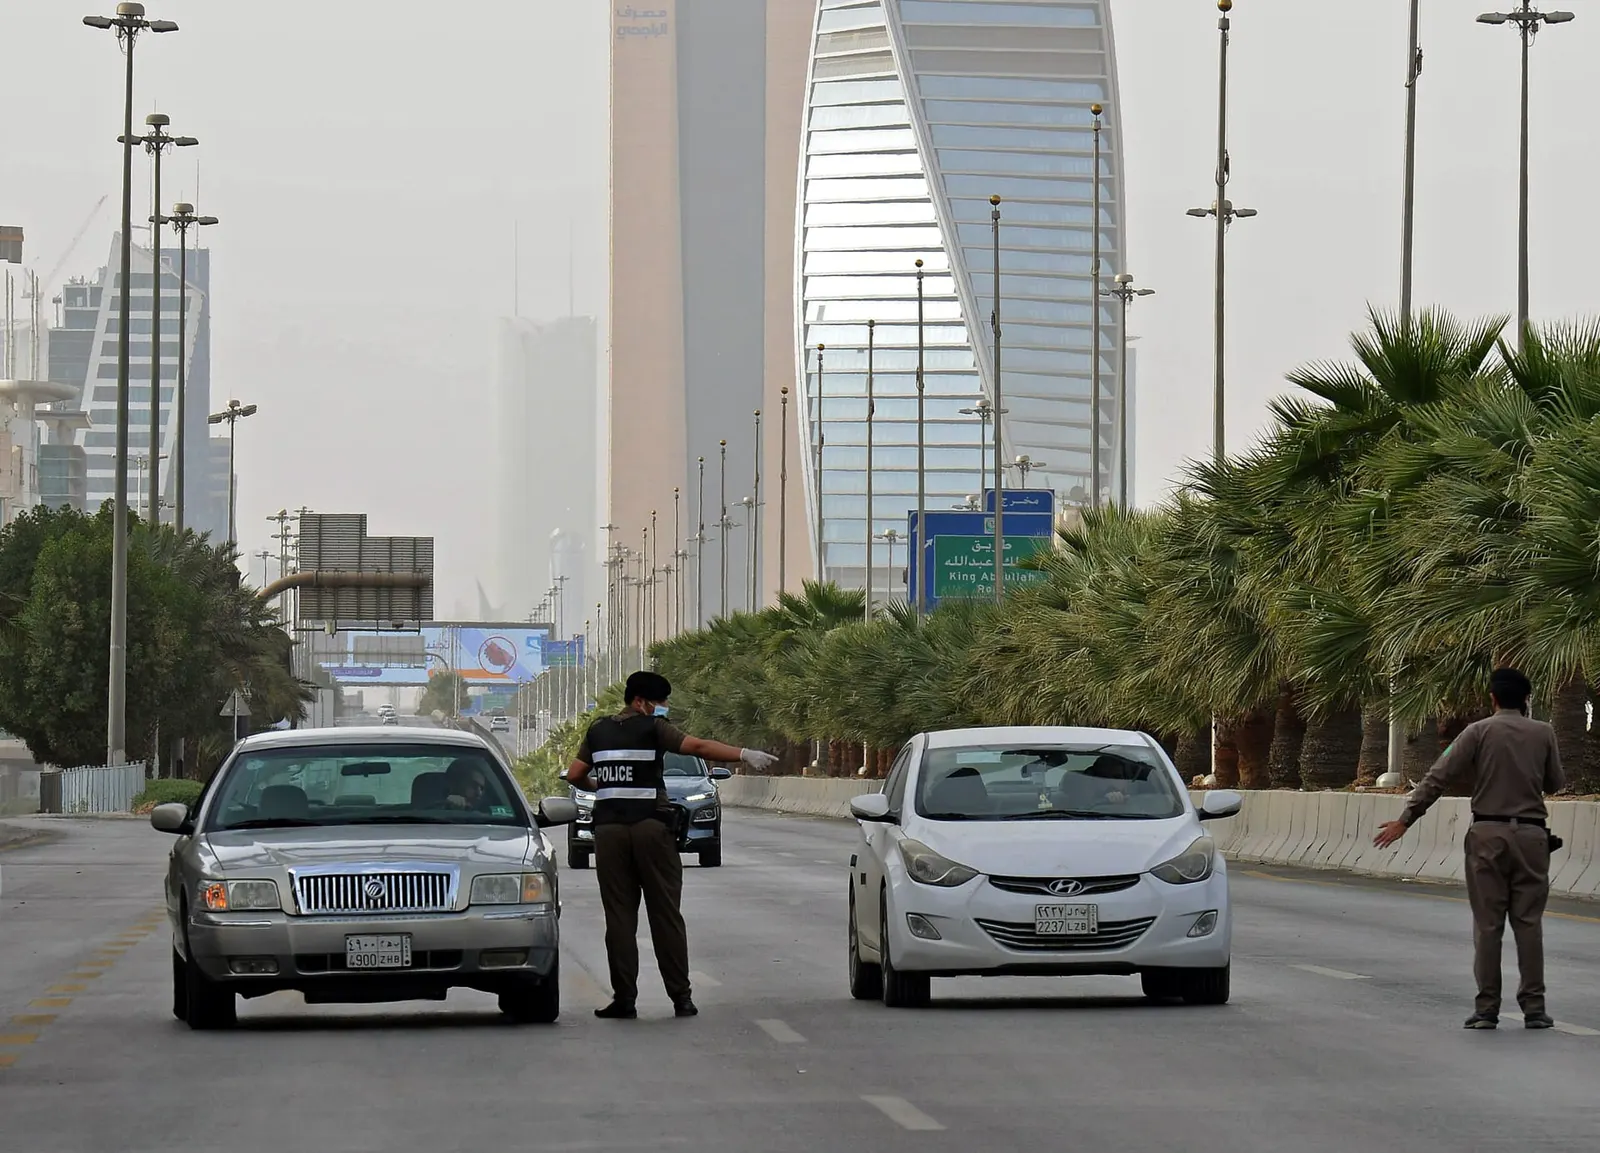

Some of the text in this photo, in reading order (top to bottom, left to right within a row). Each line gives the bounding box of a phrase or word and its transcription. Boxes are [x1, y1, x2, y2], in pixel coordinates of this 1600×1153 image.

[616, 5, 667, 20] مصرف
[616, 23, 668, 39] الراجحي
[971, 539, 1012, 552] طيق
[949, 572, 1036, 584] King Abullah
[597, 765, 633, 782] POLICE
[1038, 921, 1086, 933] 2237 LZB
[349, 954, 400, 966] 4900 ZHB
